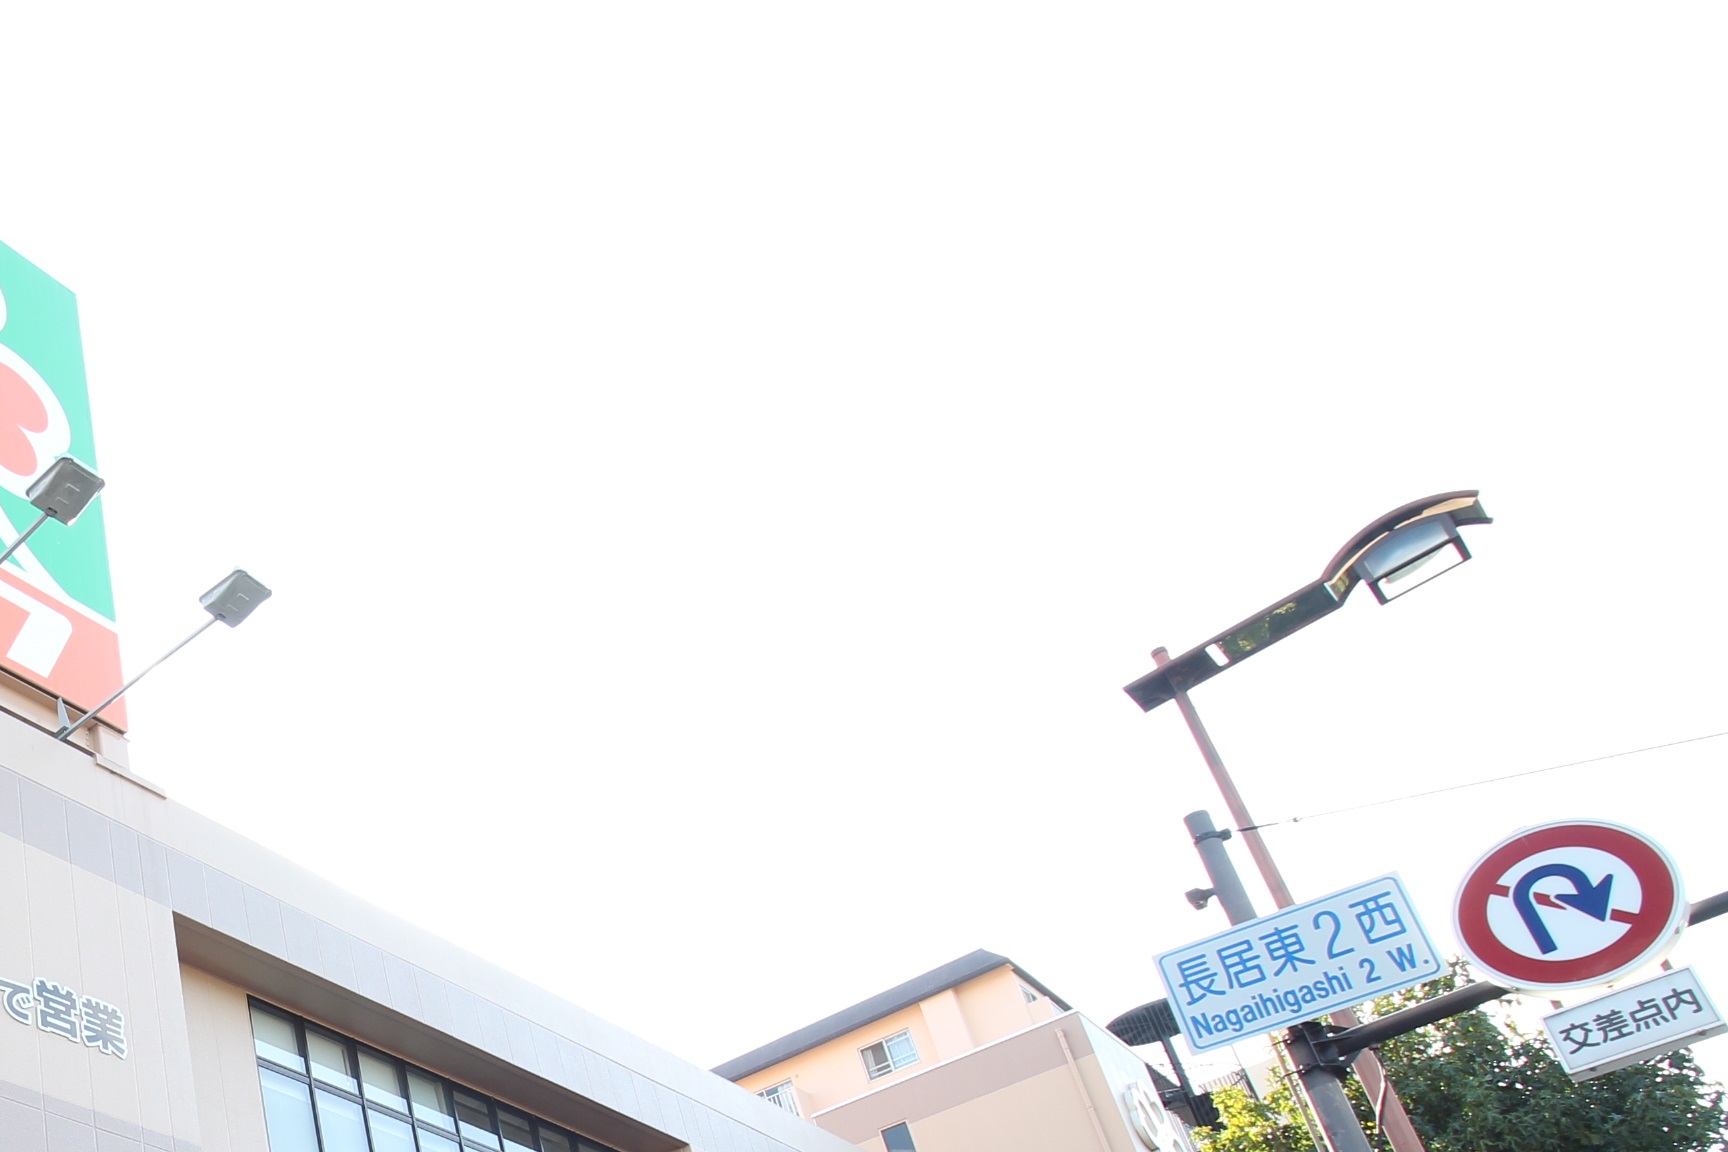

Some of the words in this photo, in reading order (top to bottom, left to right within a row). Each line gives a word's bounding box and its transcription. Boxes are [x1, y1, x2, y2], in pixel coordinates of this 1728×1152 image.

[1178, 890, 1408, 1006] 長居東2西
[1190, 966, 1354, 1039] Nagaihigashi
[1363, 959, 1382, 983] 2
[1392, 943, 1429, 970] W.
[1559, 988, 1703, 1055] 交差点内
